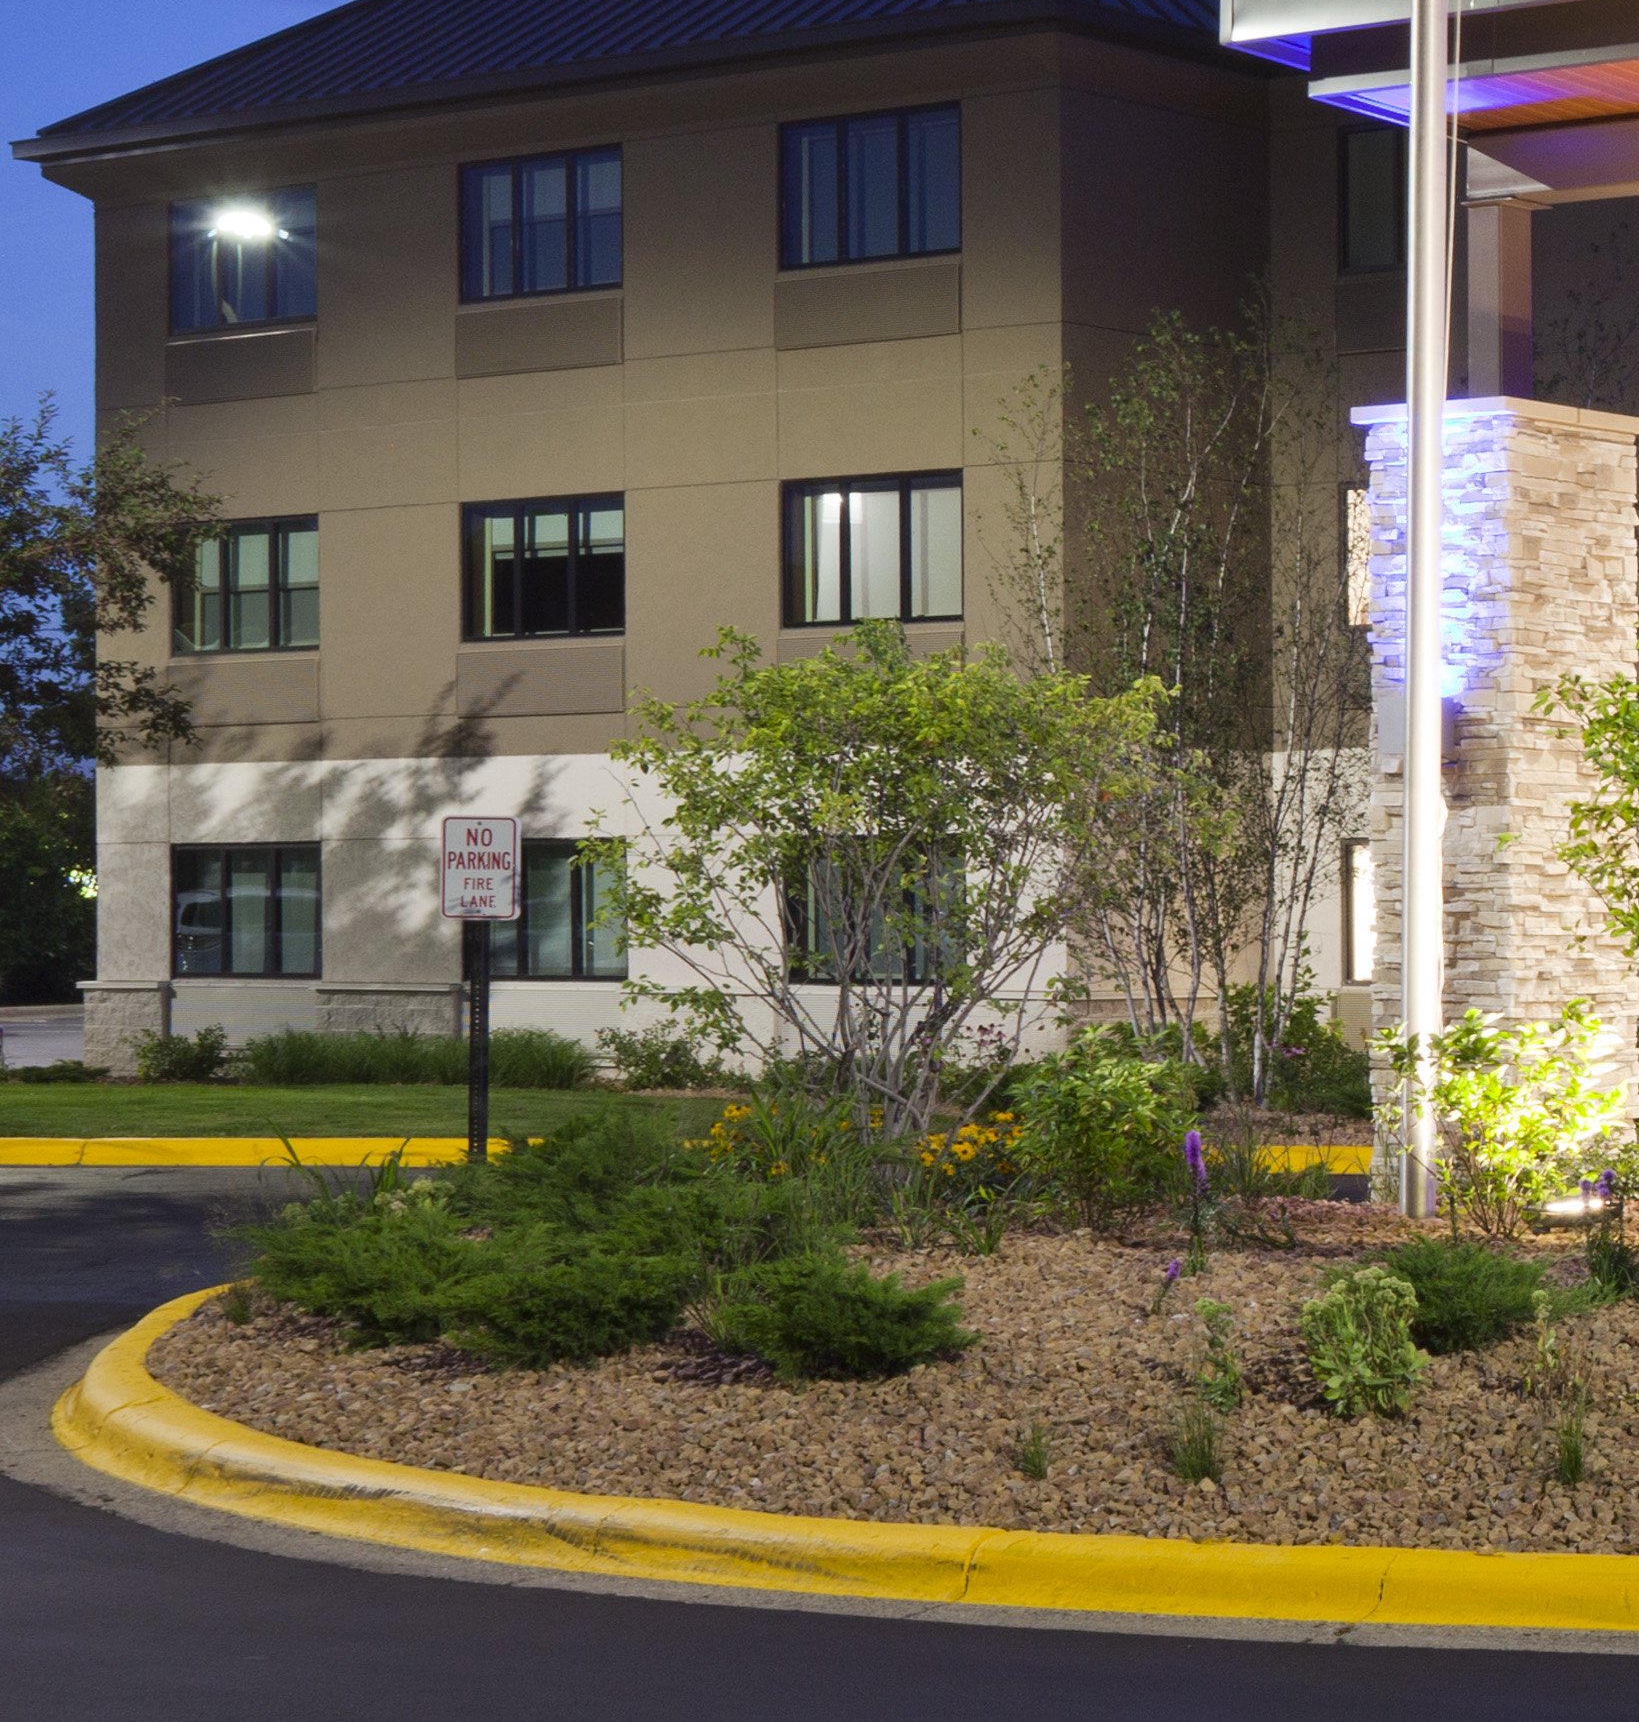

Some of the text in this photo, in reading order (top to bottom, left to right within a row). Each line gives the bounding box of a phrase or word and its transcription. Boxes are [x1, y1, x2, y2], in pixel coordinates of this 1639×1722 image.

[466, 828, 493, 847] NO
[447, 851, 511, 871] PARKING
[464, 877, 494, 891] FIRE
[460, 895, 496, 908] LANE
